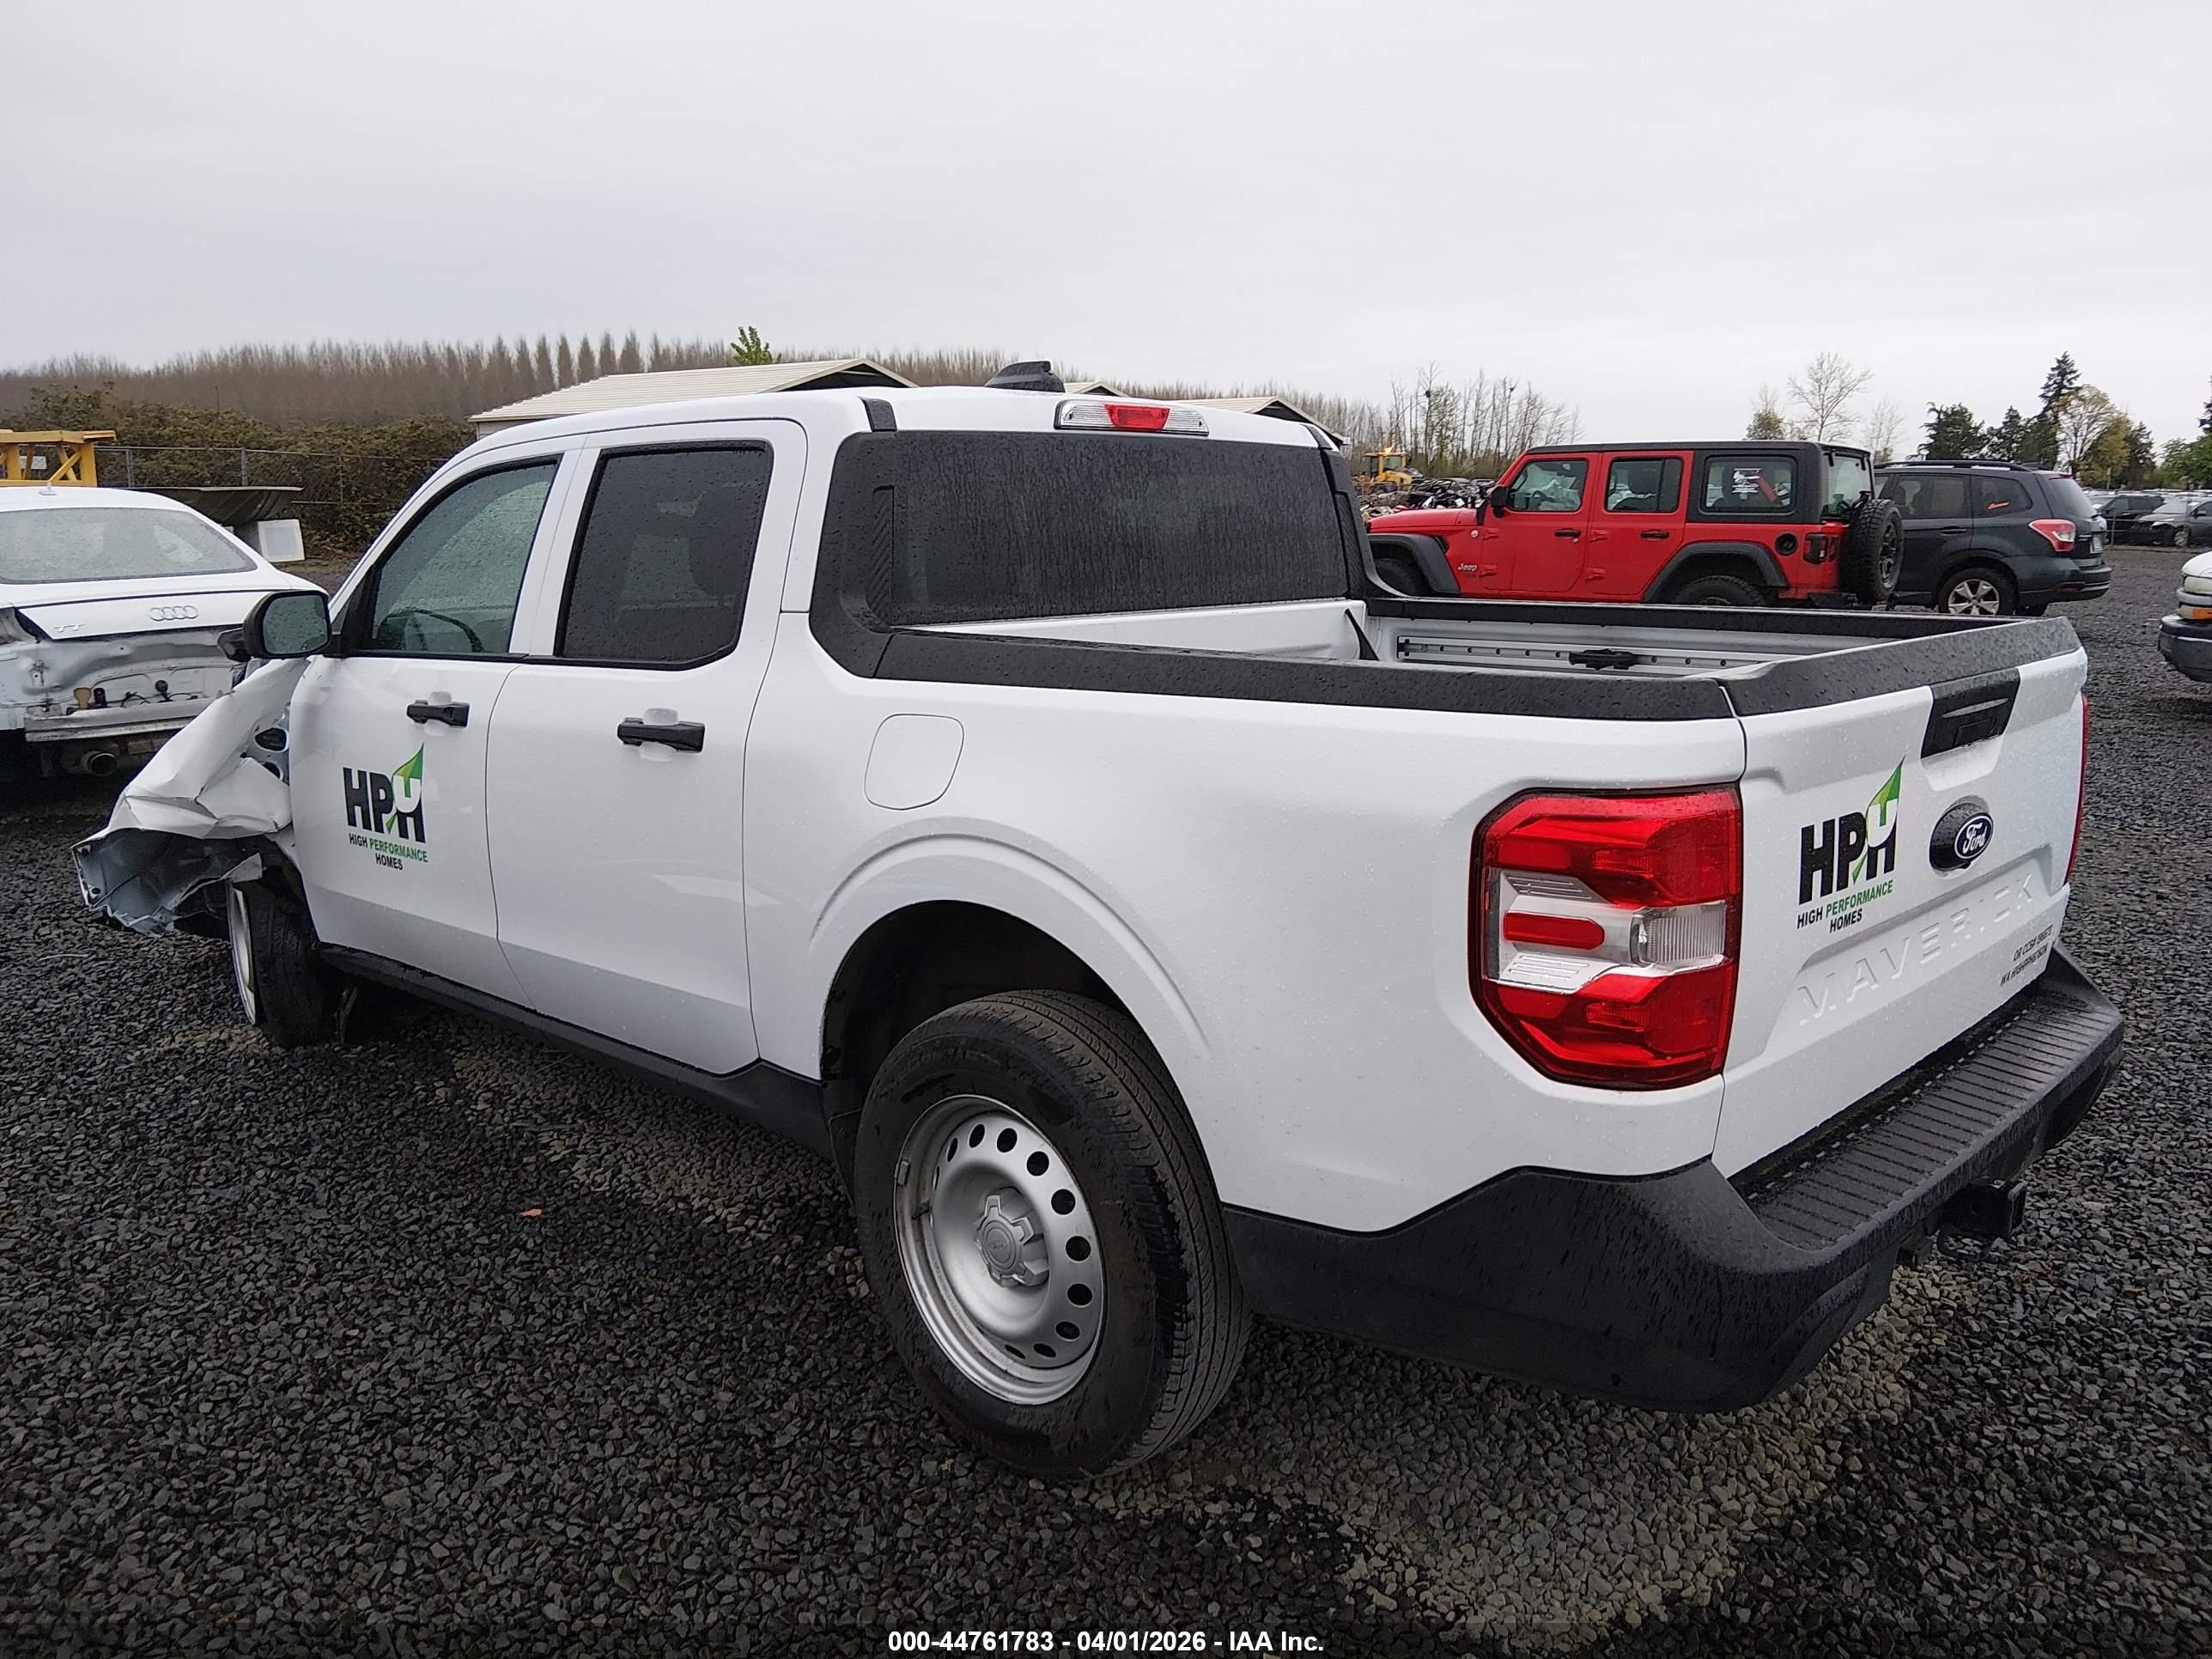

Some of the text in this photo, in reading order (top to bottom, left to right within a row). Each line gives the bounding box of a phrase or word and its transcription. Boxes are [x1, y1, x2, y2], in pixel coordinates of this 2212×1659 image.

[1457, 562, 1477, 573] Jeep
[349, 833, 428, 863] HIGH PERFORMANCE
[1962, 822, 1987, 854] Ford
[375, 853, 404, 871] HOMES
[1796, 879, 1893, 929] HIGH PERFORMANCE
[1829, 908, 1863, 933] HOMES
